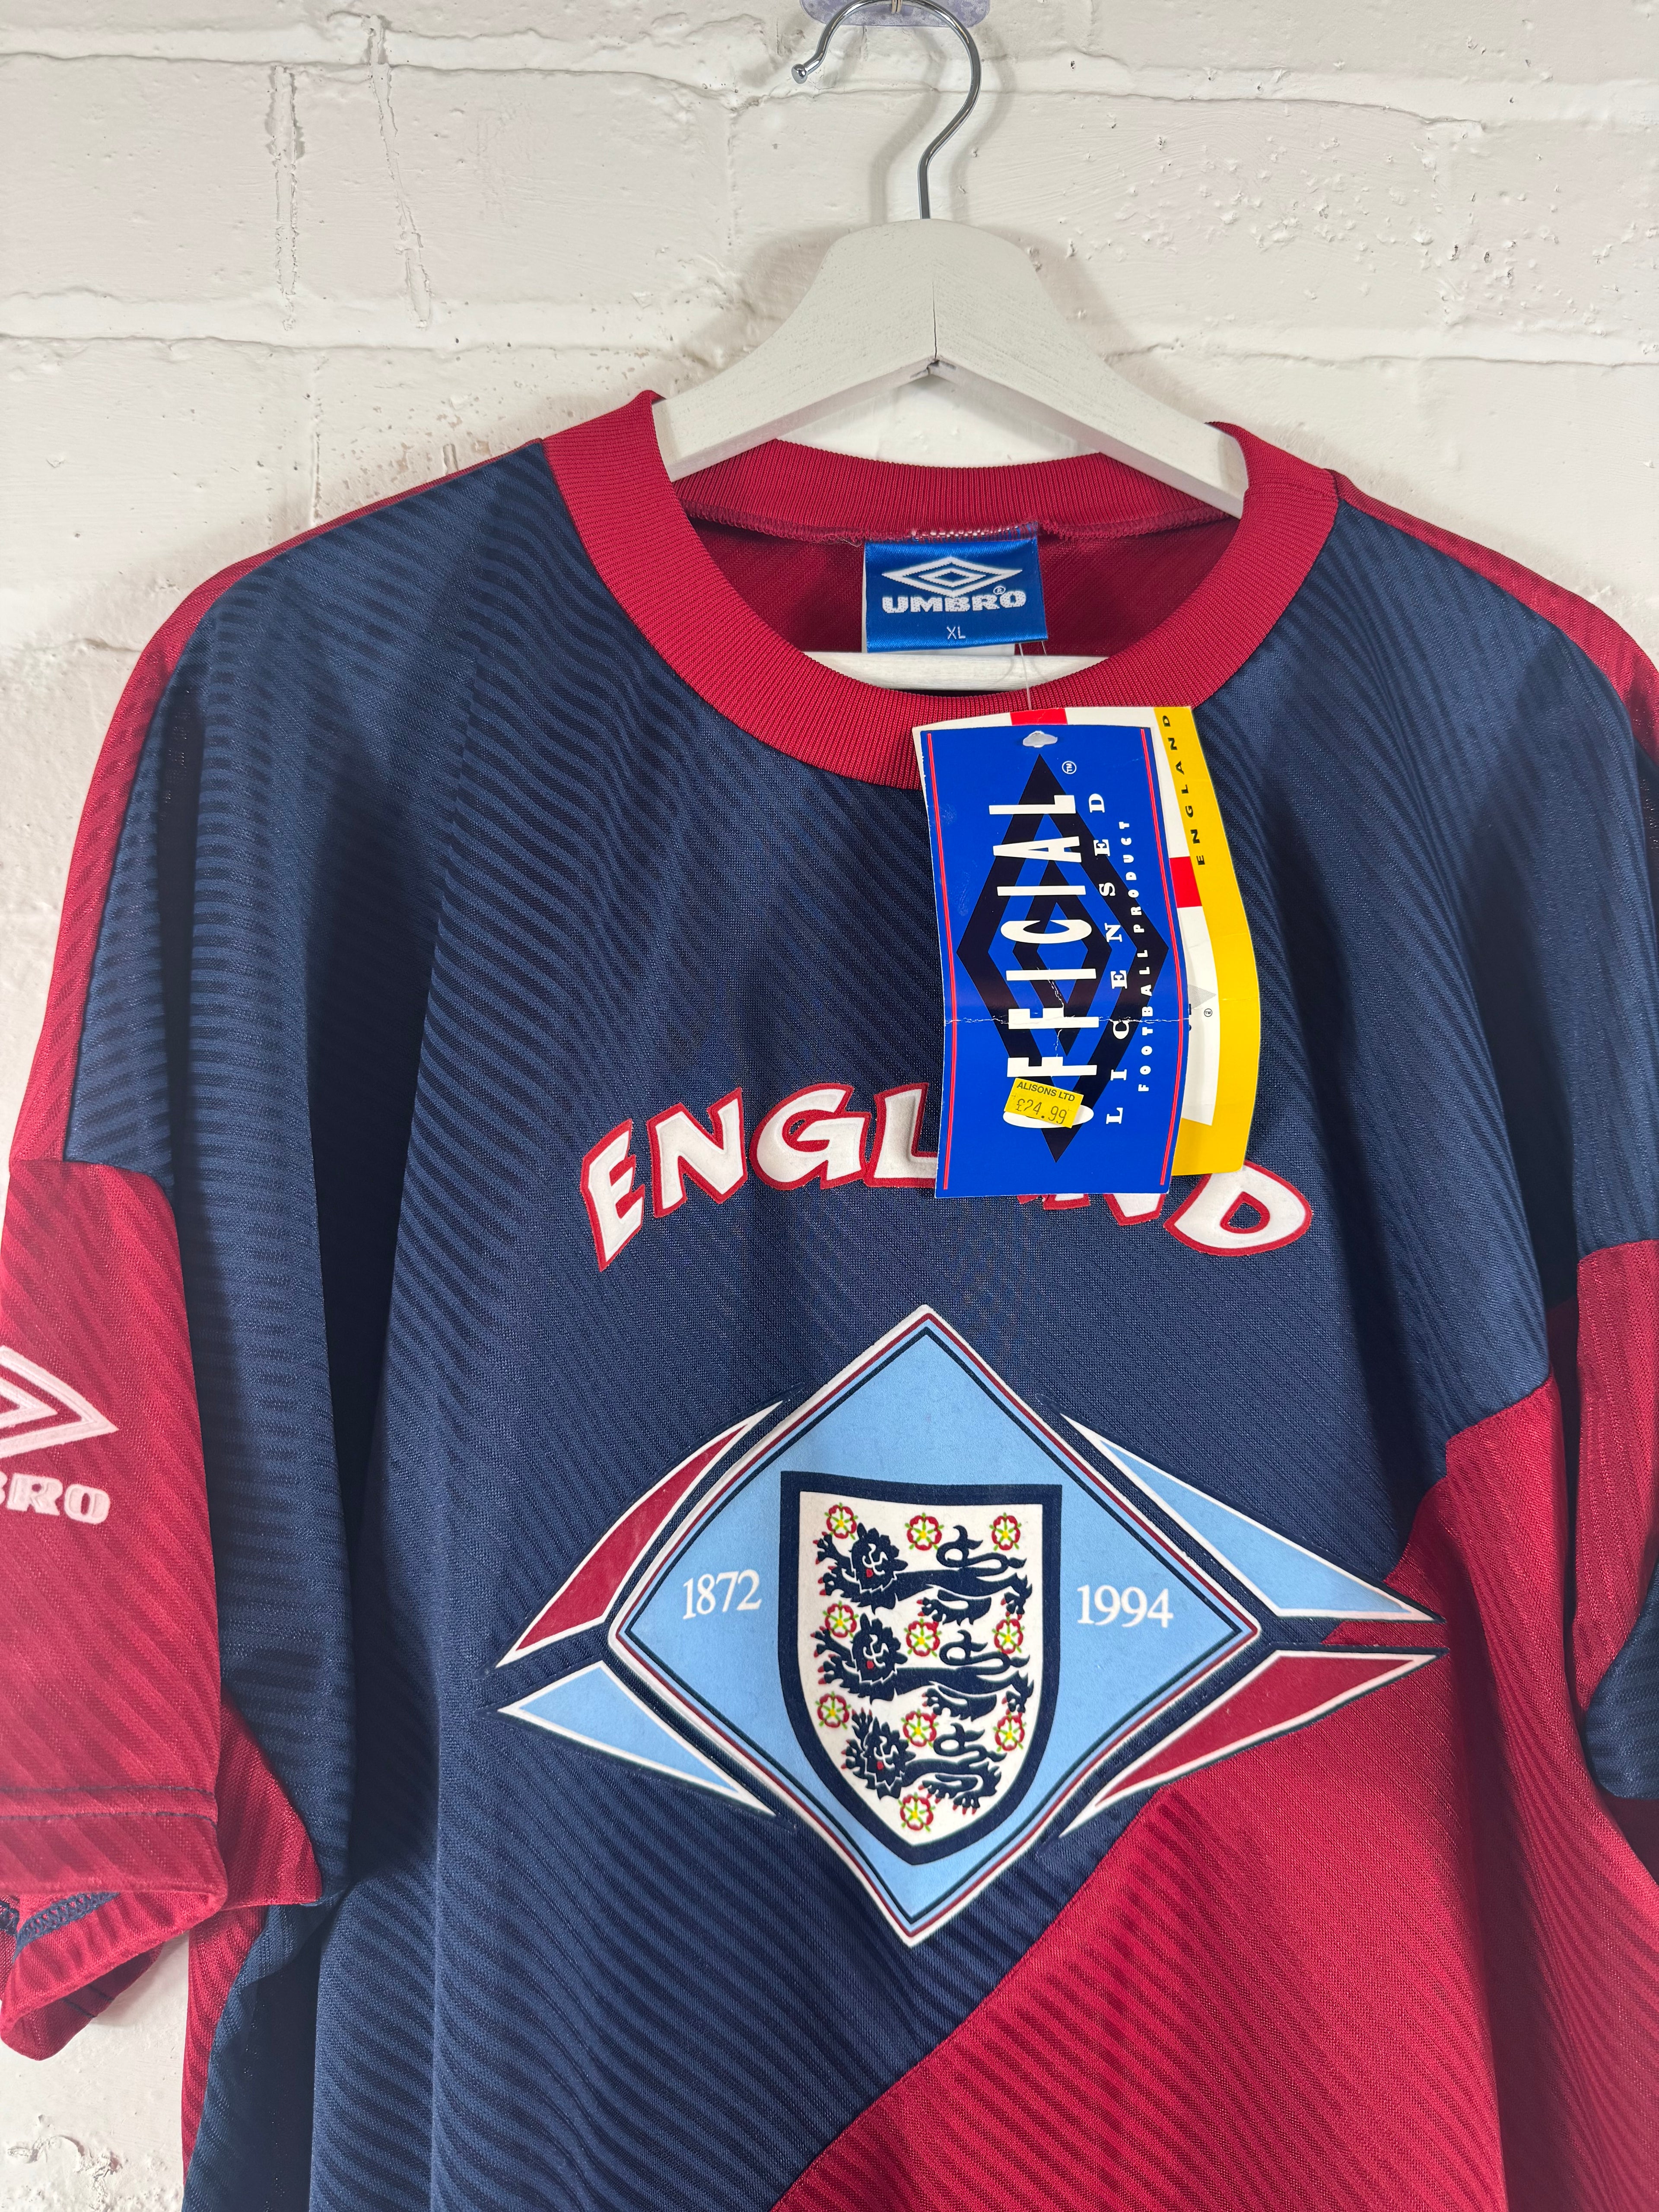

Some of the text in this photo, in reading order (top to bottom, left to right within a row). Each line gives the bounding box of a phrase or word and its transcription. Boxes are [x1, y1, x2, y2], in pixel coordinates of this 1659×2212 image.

[882, 591, 1027, 613] UMBRO
[946, 626, 966, 639] XL
[1162, 715, 1205, 865] ENGLAND
[1088, 793, 1129, 1124] LICENSED
[1119, 822, 1153, 1092] FOOTBALL PRODUCT
[1017, 1081, 1075, 1102] ALISONS LTD
[580, 1082, 1313, 1272] ENGLD
[0, 1471, 111, 1524] RO
[681, 1569, 762, 1619] 1872
[1077, 1583, 1174, 1628] 1994
